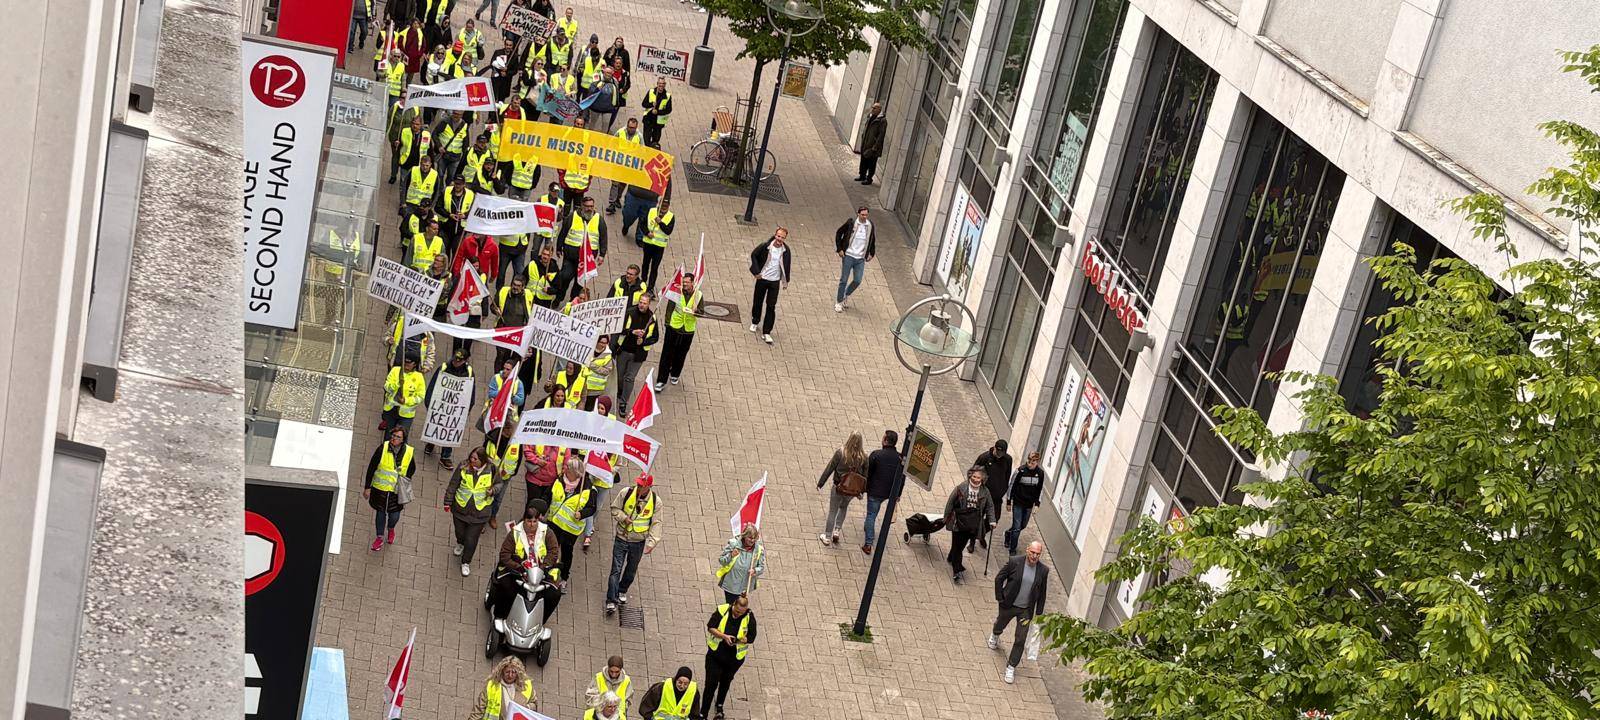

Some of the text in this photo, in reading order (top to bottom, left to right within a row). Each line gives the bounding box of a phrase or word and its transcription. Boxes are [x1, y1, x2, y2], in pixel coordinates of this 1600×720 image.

[511, 17, 548, 40] HANDEL
[656, 64, 685, 78] RESPEKT
[510, 132, 645, 171] PAUL MUSS BLEIBEN!
[265, 122, 296, 200] HAND
[487, 209, 524, 220] Kamen
[249, 207, 283, 313] SECOND
[379, 259, 402, 274] UNSERE
[377, 268, 397, 284] EUCH
[399, 276, 427, 298] REICH
[370, 281, 415, 311] UMVERTEILEN
[587, 301, 601, 309] DEN
[601, 297, 625, 308] UMSATZ
[570, 320, 595, 338] WEG
[440, 376, 465, 392] OHNE
[442, 390, 460, 404] UNS
[429, 411, 461, 428] KEIN
[525, 419, 557, 428] Kaufland
[424, 423, 463, 442] LADEN
[522, 426, 607, 444] Arnsberg Bruchhausen
